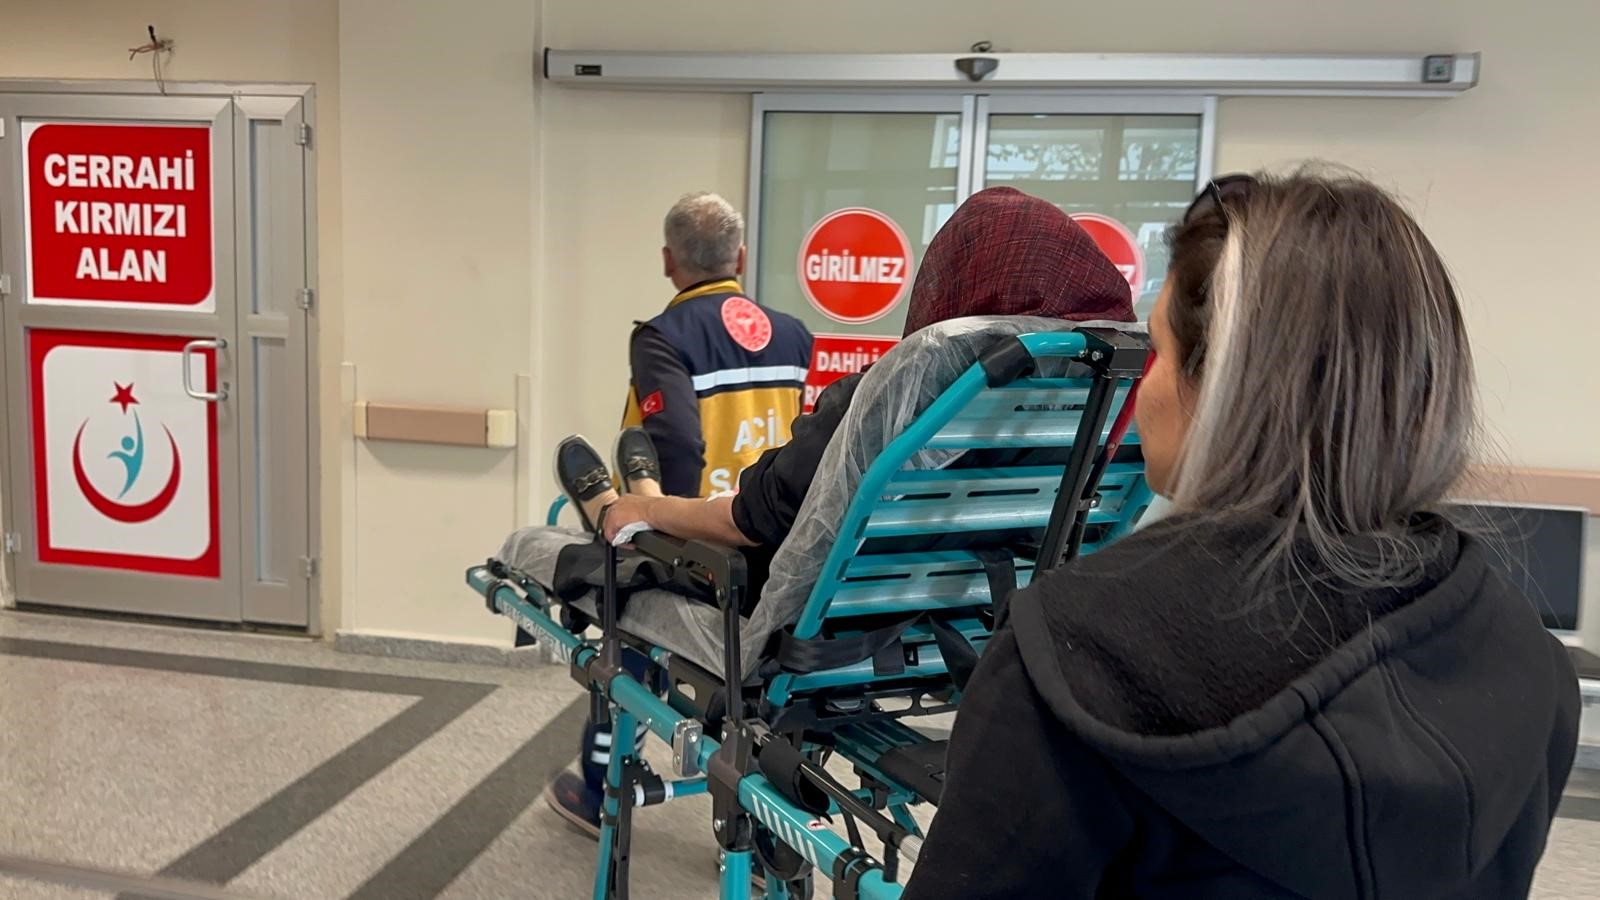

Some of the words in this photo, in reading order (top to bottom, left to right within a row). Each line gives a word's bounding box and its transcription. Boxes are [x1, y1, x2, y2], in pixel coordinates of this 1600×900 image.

[43, 150, 195, 190] CERRAHİ
[54, 201, 186, 238] KIRMIZI
[75, 247, 167, 283] ALAN
[806, 249, 905, 284] GİRİLMEZ
